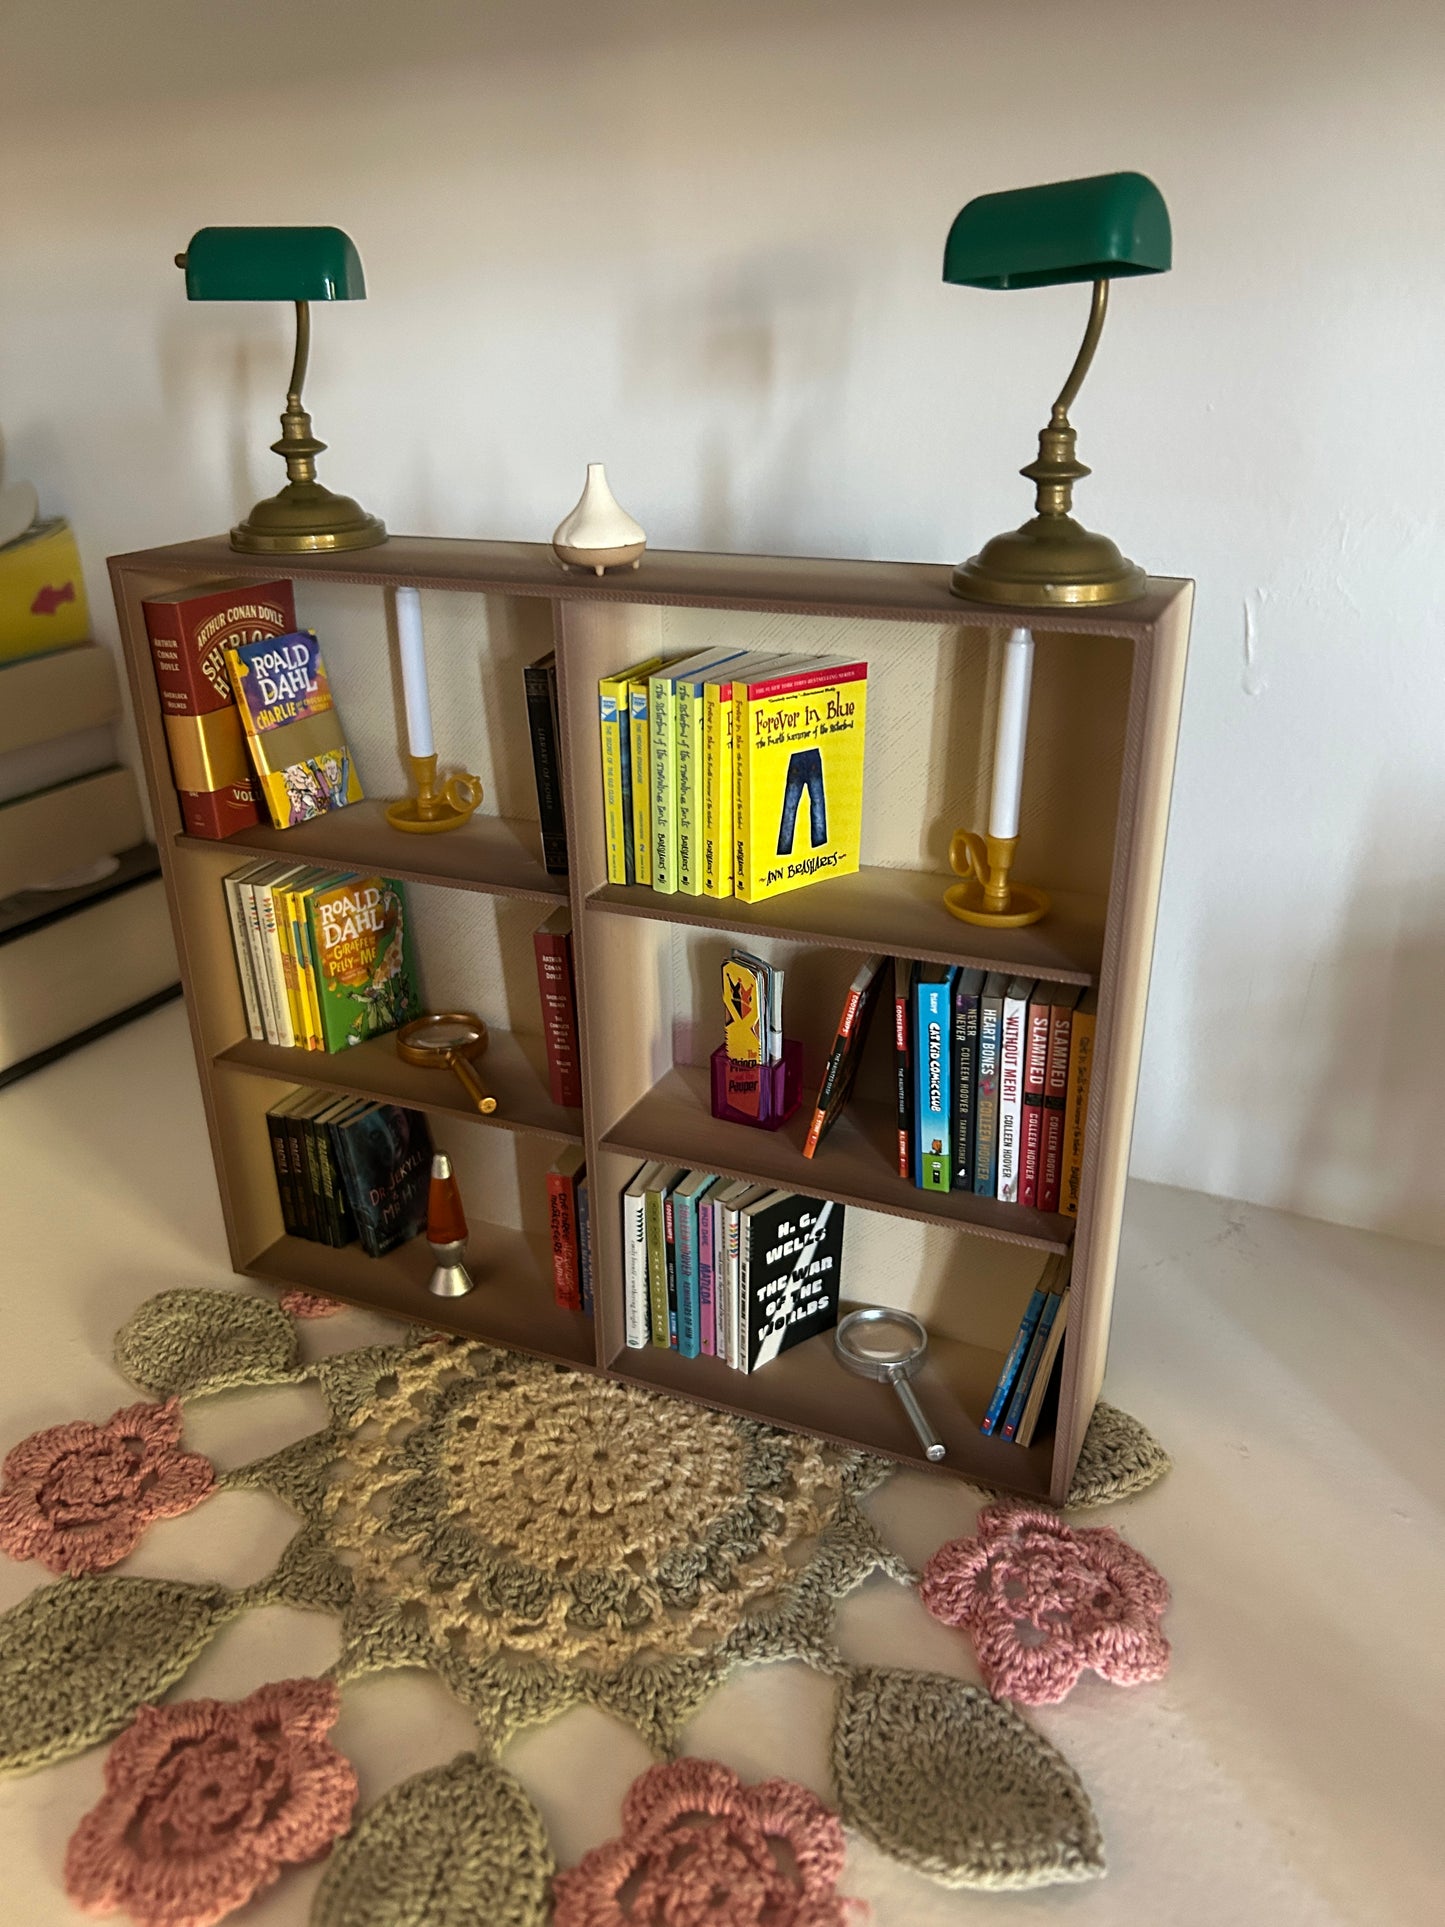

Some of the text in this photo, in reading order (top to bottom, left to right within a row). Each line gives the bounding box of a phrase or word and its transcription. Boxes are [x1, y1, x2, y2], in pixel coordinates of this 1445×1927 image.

[154, 638, 178, 648] ARTHUR
[197, 605, 285, 652] ARTHUR CONAN DOYLE
[157, 650, 178, 660] CONAN
[160, 661, 180, 672] DOYLE
[251, 644, 310, 679] ROALD
[259, 667, 318, 706] DAHL
[256, 701, 297, 730] CHARLIE
[755, 709, 800, 736] Forever
[826, 691, 854, 720] Blue
[768, 732, 784, 746] Fourth
[812, 726, 818, 739] of
[820, 723, 828, 734] the
[766, 867, 784, 886] ANN
[320, 888, 380, 926] ROALD
[323, 909, 384, 950] DAHL
[329, 957, 354, 976] PELLY
[360, 947, 376, 966] ME
[334, 936, 369, 960] GIRAFFE
[844, 994, 858, 1034] GOOSEBUMPS
[896, 1005, 904, 1046] GOOSEBUMPS
[930, 1022, 941, 1040] CAT
[956, 1013, 966, 1041] NEVER
[967, 1008, 978, 1036] NEVER
[982, 1008, 997, 1076] HEART BONES
[1003, 1016, 1020, 1104] WITHOUT MERIT
[1030, 1017, 1048, 1085] SLAMMED
[1050, 1020, 1070, 1088] SLAMMED
[730, 1058, 756, 1072] Prince
[960, 1047, 970, 1113] COLLEEN HOOVER
[729, 1080, 758, 1094] Pauper
[930, 1089, 942, 1112] CLUB
[958, 1143, 966, 1164] FISHER
[978, 1101, 992, 1180] COLLEEN HOOVER
[1002, 1114, 1014, 1178] COLLEEN HOOVER
[1026, 1113, 1038, 1180] COLLEEN HOOVER
[1046, 1116, 1059, 1184] COLLEEN HOOVER
[369, 1187, 386, 1206] DR
[678, 1204, 692, 1277] COLLEEN HOOVER
[778, 1212, 817, 1238] H. G.
[766, 1228, 826, 1264] WELLS
[700, 1262, 712, 1304] MATILDA
[757, 1256, 833, 1302] THE WAR
[766, 1278, 822, 1316] OF THE
[683, 1280, 692, 1316] REMINDERS
[630, 1309, 638, 1328] heights
[684, 1317, 692, 1326] OF
[758, 1296, 830, 1341] WORLDS
